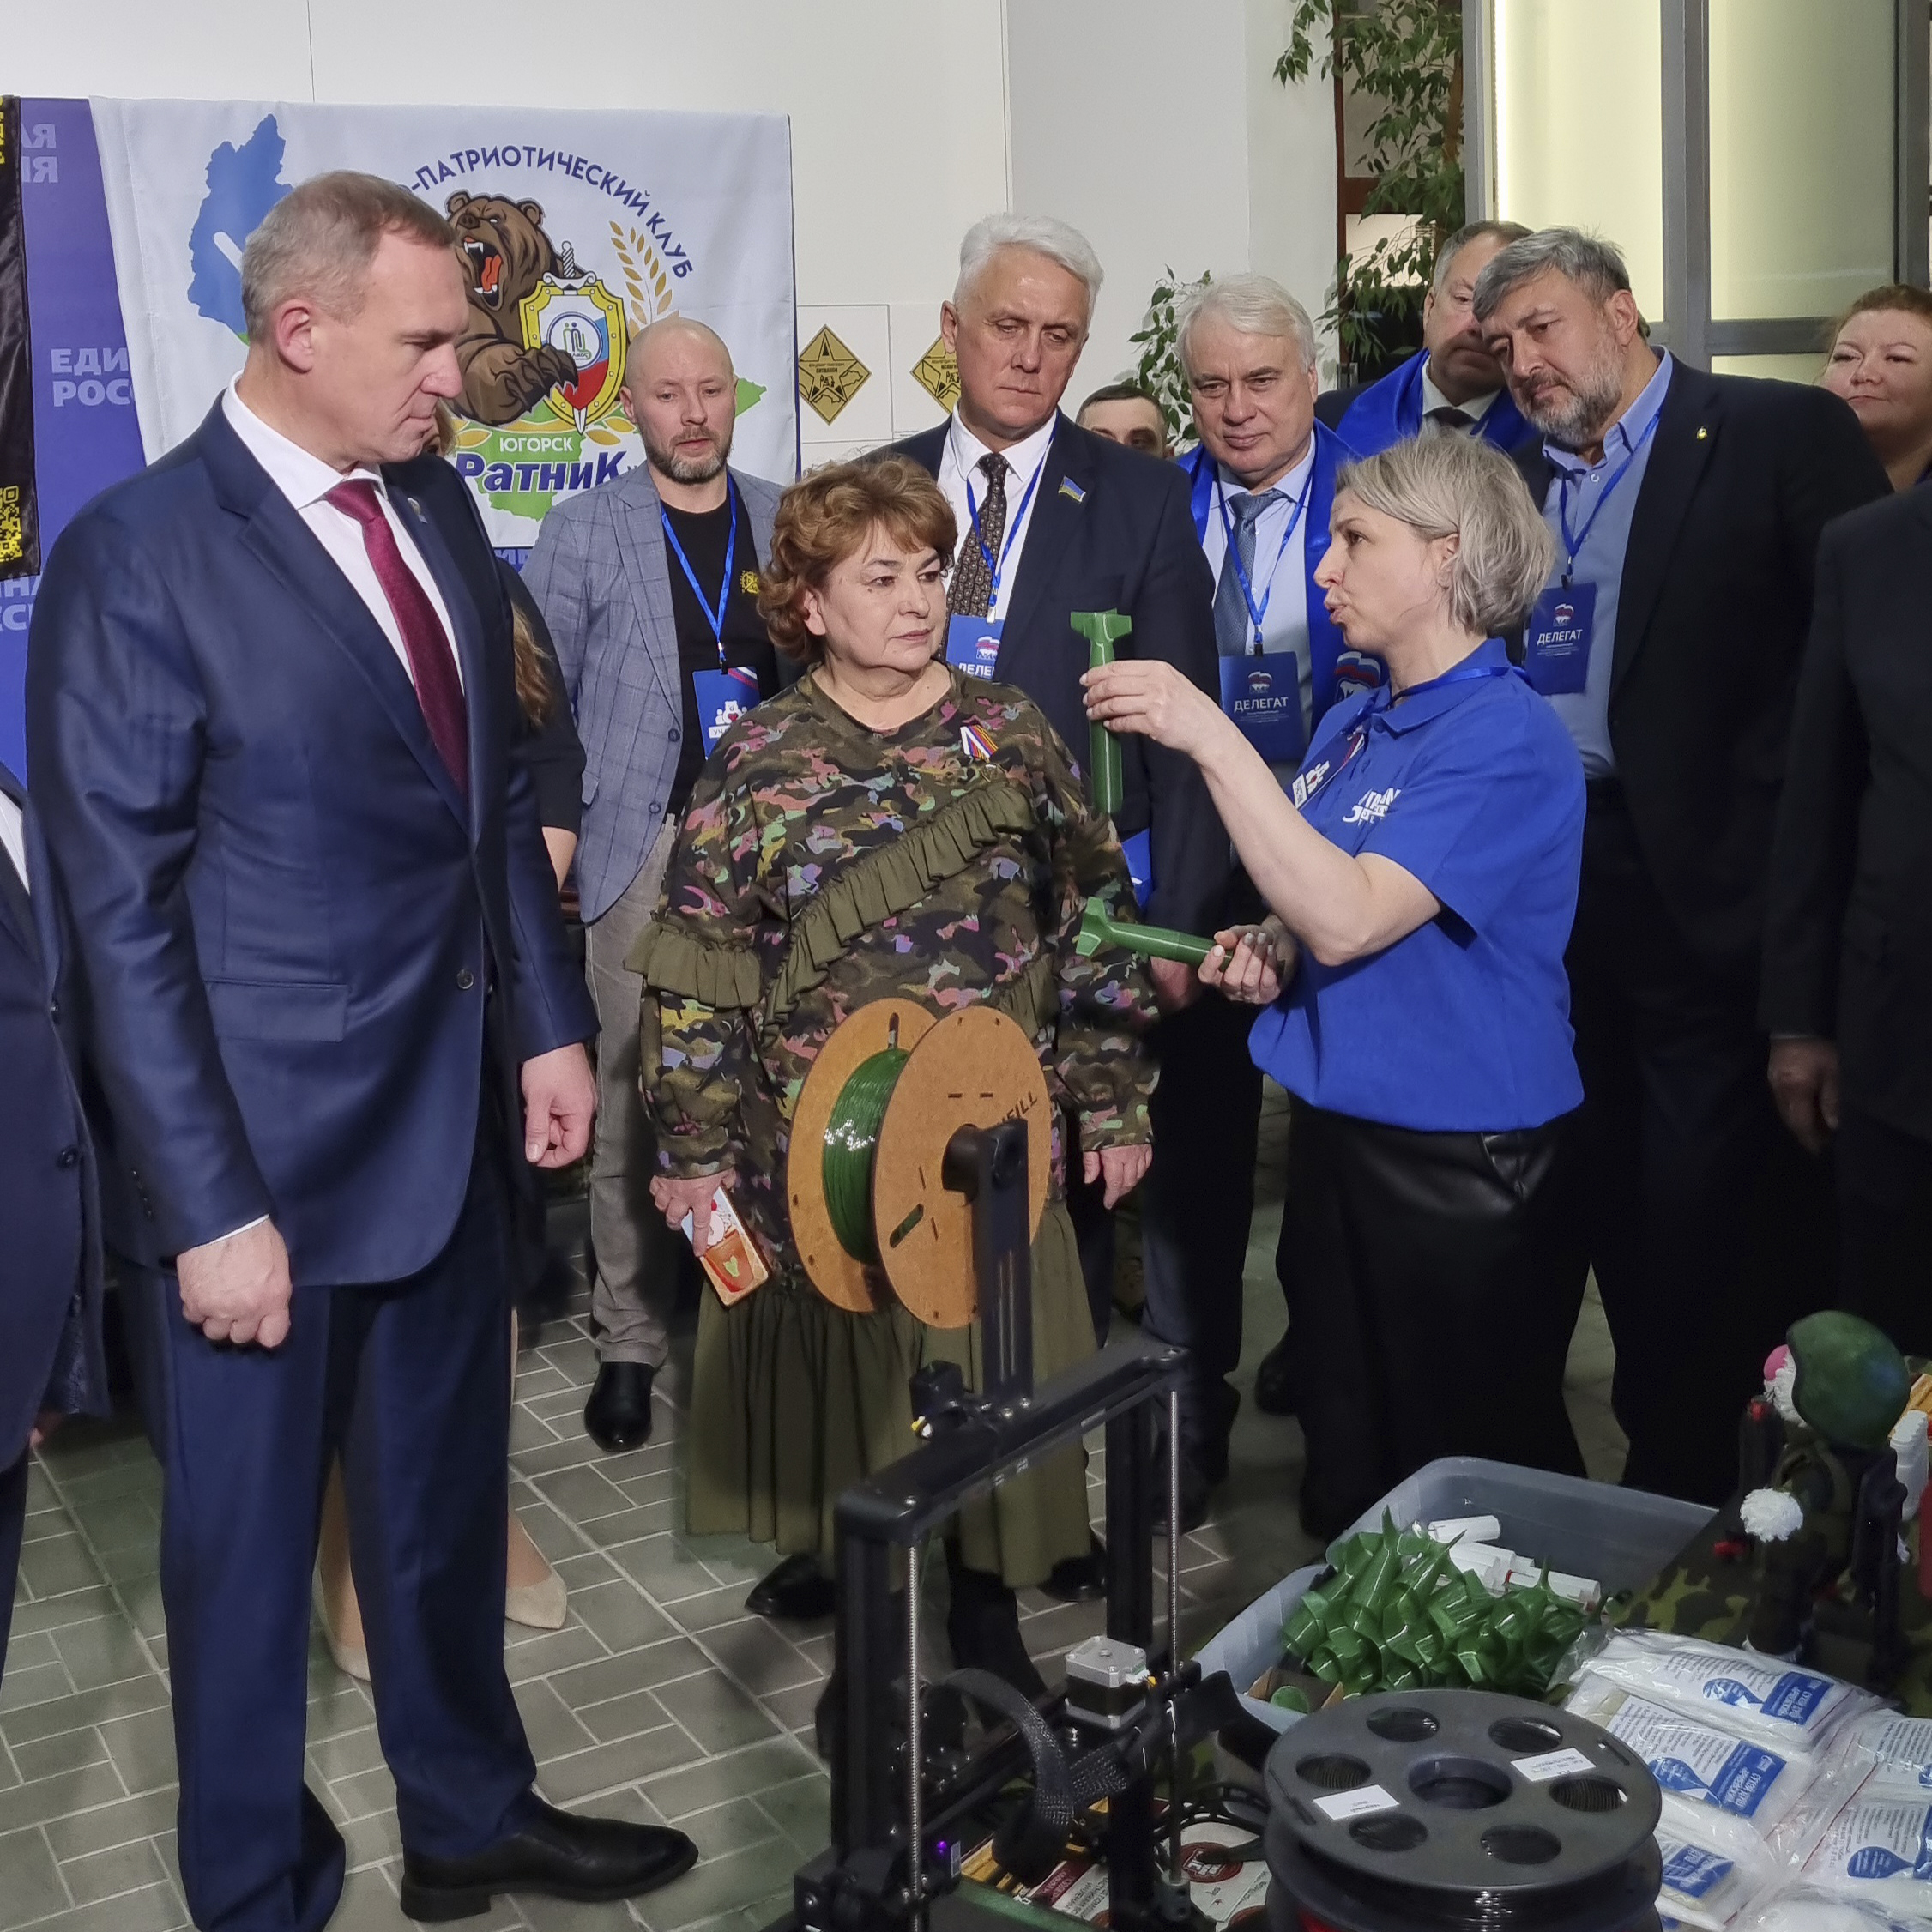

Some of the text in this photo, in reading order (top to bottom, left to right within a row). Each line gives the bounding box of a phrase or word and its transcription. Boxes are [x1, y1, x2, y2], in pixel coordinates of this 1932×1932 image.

[407, 145, 693, 278] -ПАТРИОТИЧЕСКИЙ КЛУБ
[53, 378, 135, 407] РОС
[499, 436, 574, 452] ЮГОРСК
[1537, 629, 1583, 646] ДЕЛЕГАТ
[1234, 697, 1289, 713] ДЕЛЕГАТ
